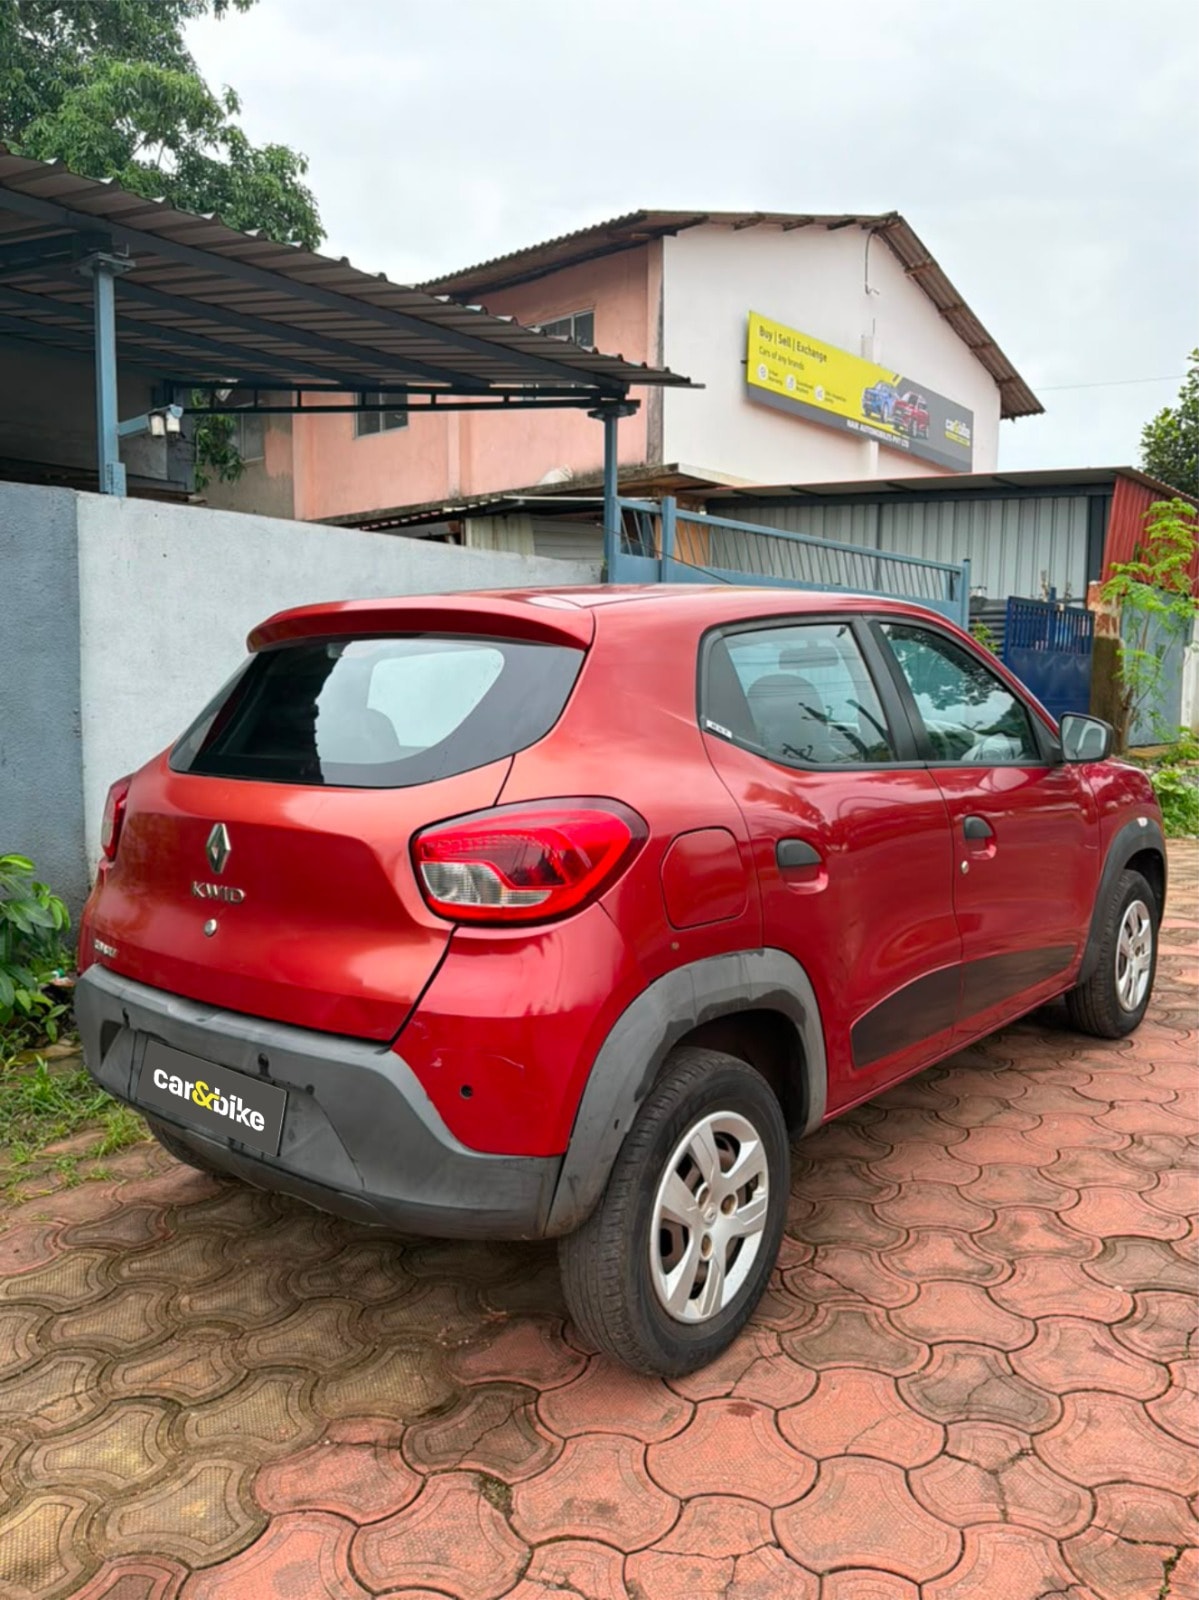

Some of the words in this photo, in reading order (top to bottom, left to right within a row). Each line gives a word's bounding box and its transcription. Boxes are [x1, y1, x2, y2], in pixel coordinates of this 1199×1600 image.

[759, 325, 773, 342] Buy
[778, 333, 791, 348] Sell
[796, 340, 827, 363] Exchange
[759, 346, 771, 357] Cars
[771, 350, 778, 359] of
[778, 355, 787, 365] any
[787, 356, 805, 370] brands
[191, 880, 246, 904] KWID
